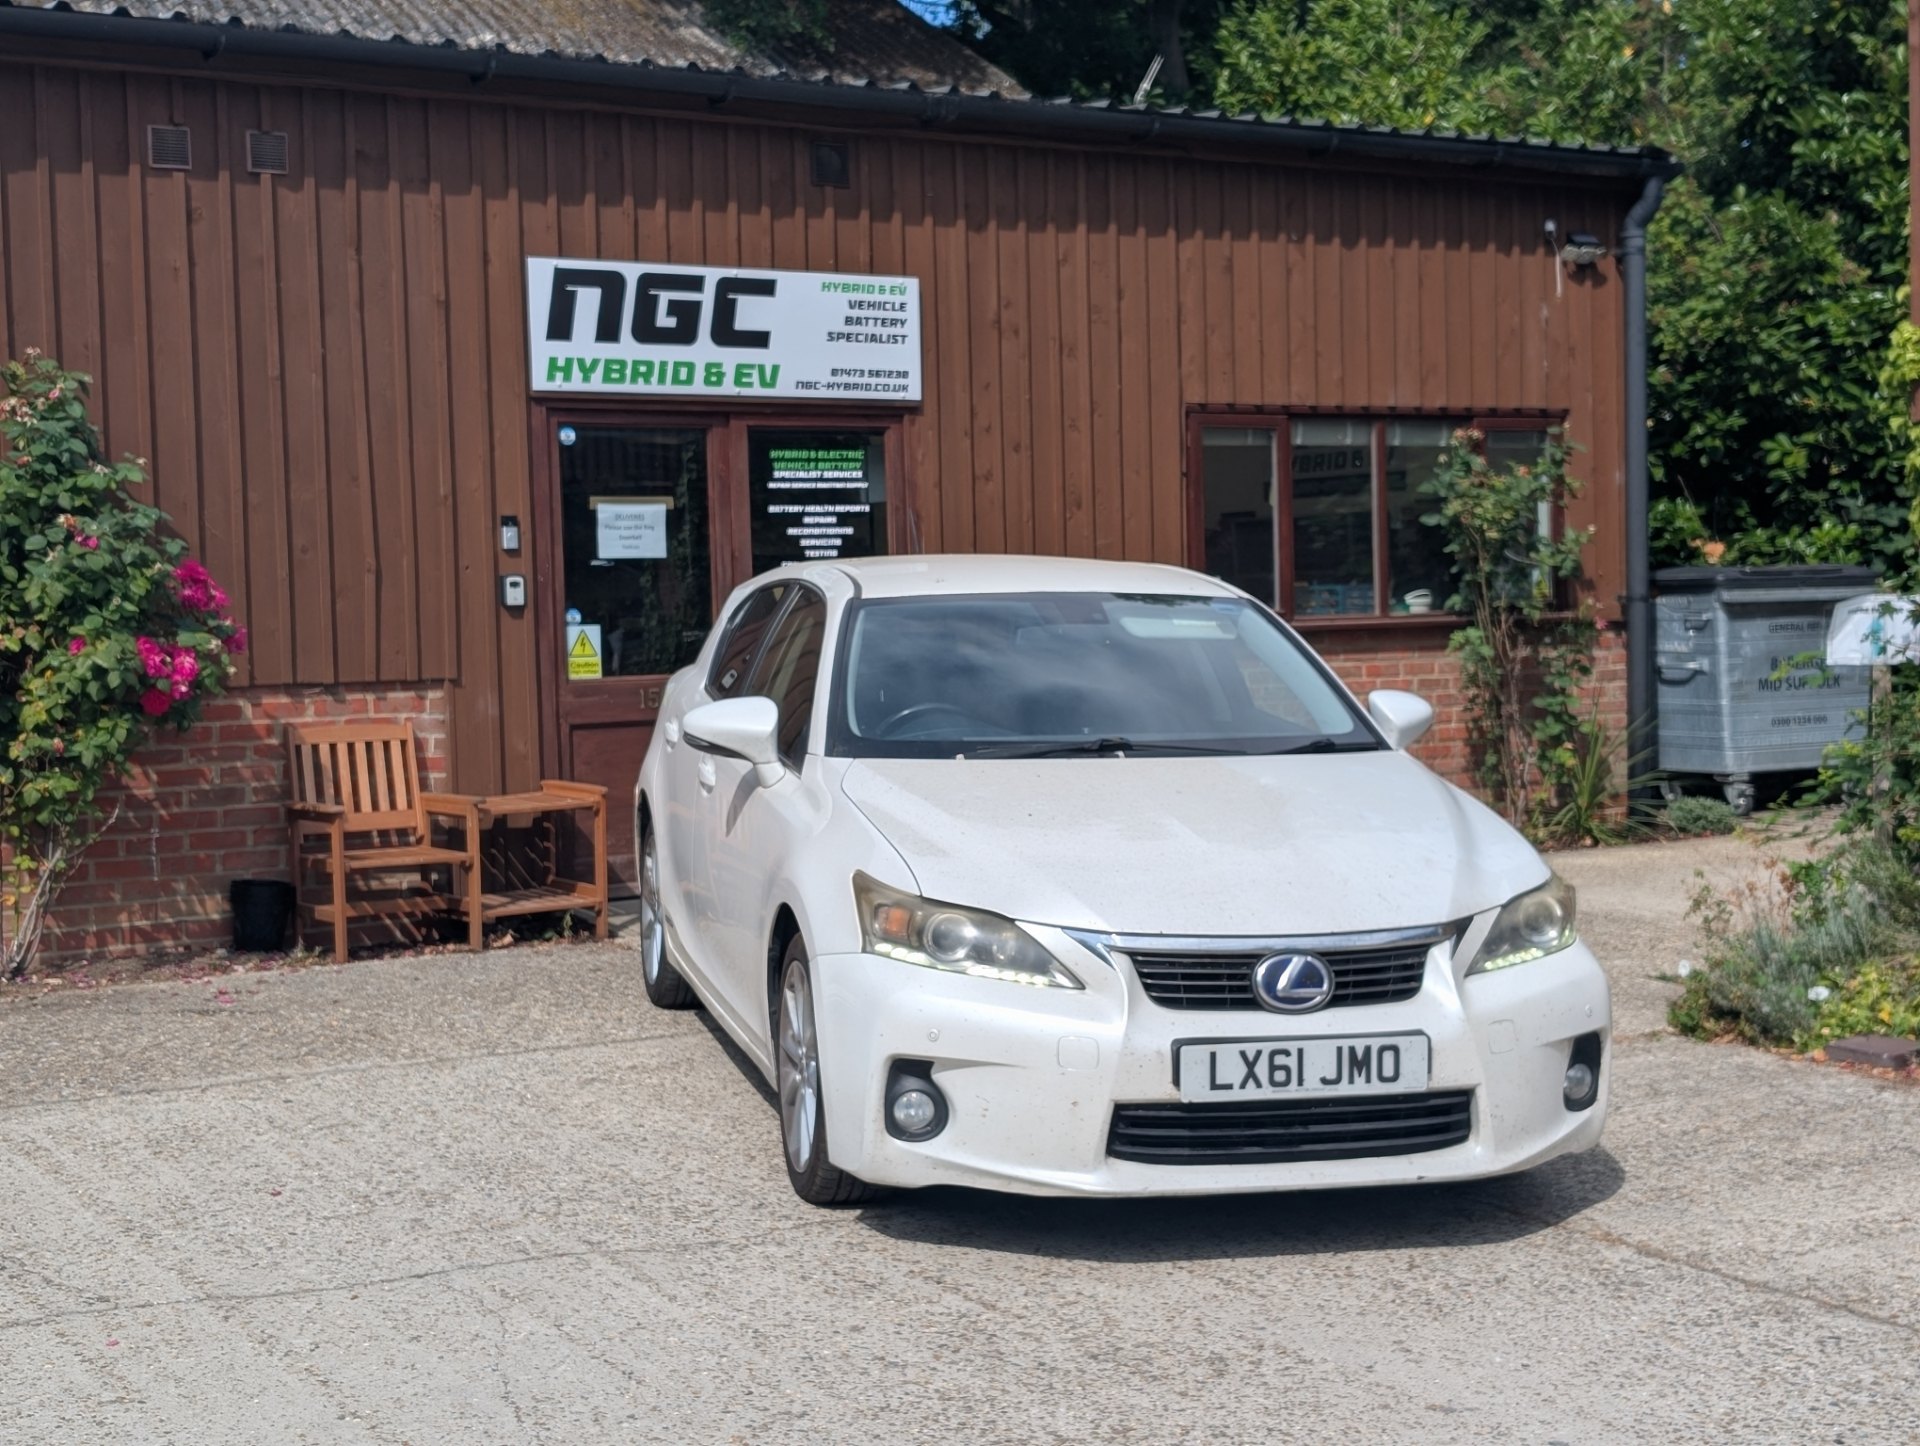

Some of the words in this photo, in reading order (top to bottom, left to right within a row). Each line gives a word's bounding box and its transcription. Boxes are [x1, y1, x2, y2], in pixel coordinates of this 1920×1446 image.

[821, 282, 875, 295] HYBRID
[878, 285, 887, 295] &
[889, 285, 908, 296] EV
[546, 267, 777, 349] NGC
[848, 299, 908, 312] VEHICLE
[844, 316, 908, 328] BATTERY
[826, 331, 909, 345] SPECIALIST
[546, 357, 696, 387] HYBRID
[703, 361, 726, 387] &
[733, 363, 781, 389] EV
[831, 368, 865, 378] 01473
[795, 381, 909, 393] NGC-HYBRID.CO.UK
[769, 450, 809, 459] HYBRID
[817, 450, 865, 459] ELECTRIC
[772, 461, 816, 470] VEHICLE
[818, 461, 862, 470] BATTERY
[767, 504, 803, 513] BATTERY
[804, 504, 834, 513] HEALTH
[835, 504, 870, 513] REPORTS
[802, 516, 837, 524] REPAIRS
[786, 527, 854, 535] RECONDITIONING
[799, 538, 842, 547] SERVICING
[804, 549, 838, 557] TESTING
[1768, 621, 1804, 633] GENERAL
[1758, 677, 1782, 692] MID
[1786, 673, 1841, 691] SUOLK
[639, 687, 660, 709] 15
[1209, 1047, 1304, 1091] LX61
[1319, 1044, 1400, 1086] JMO
